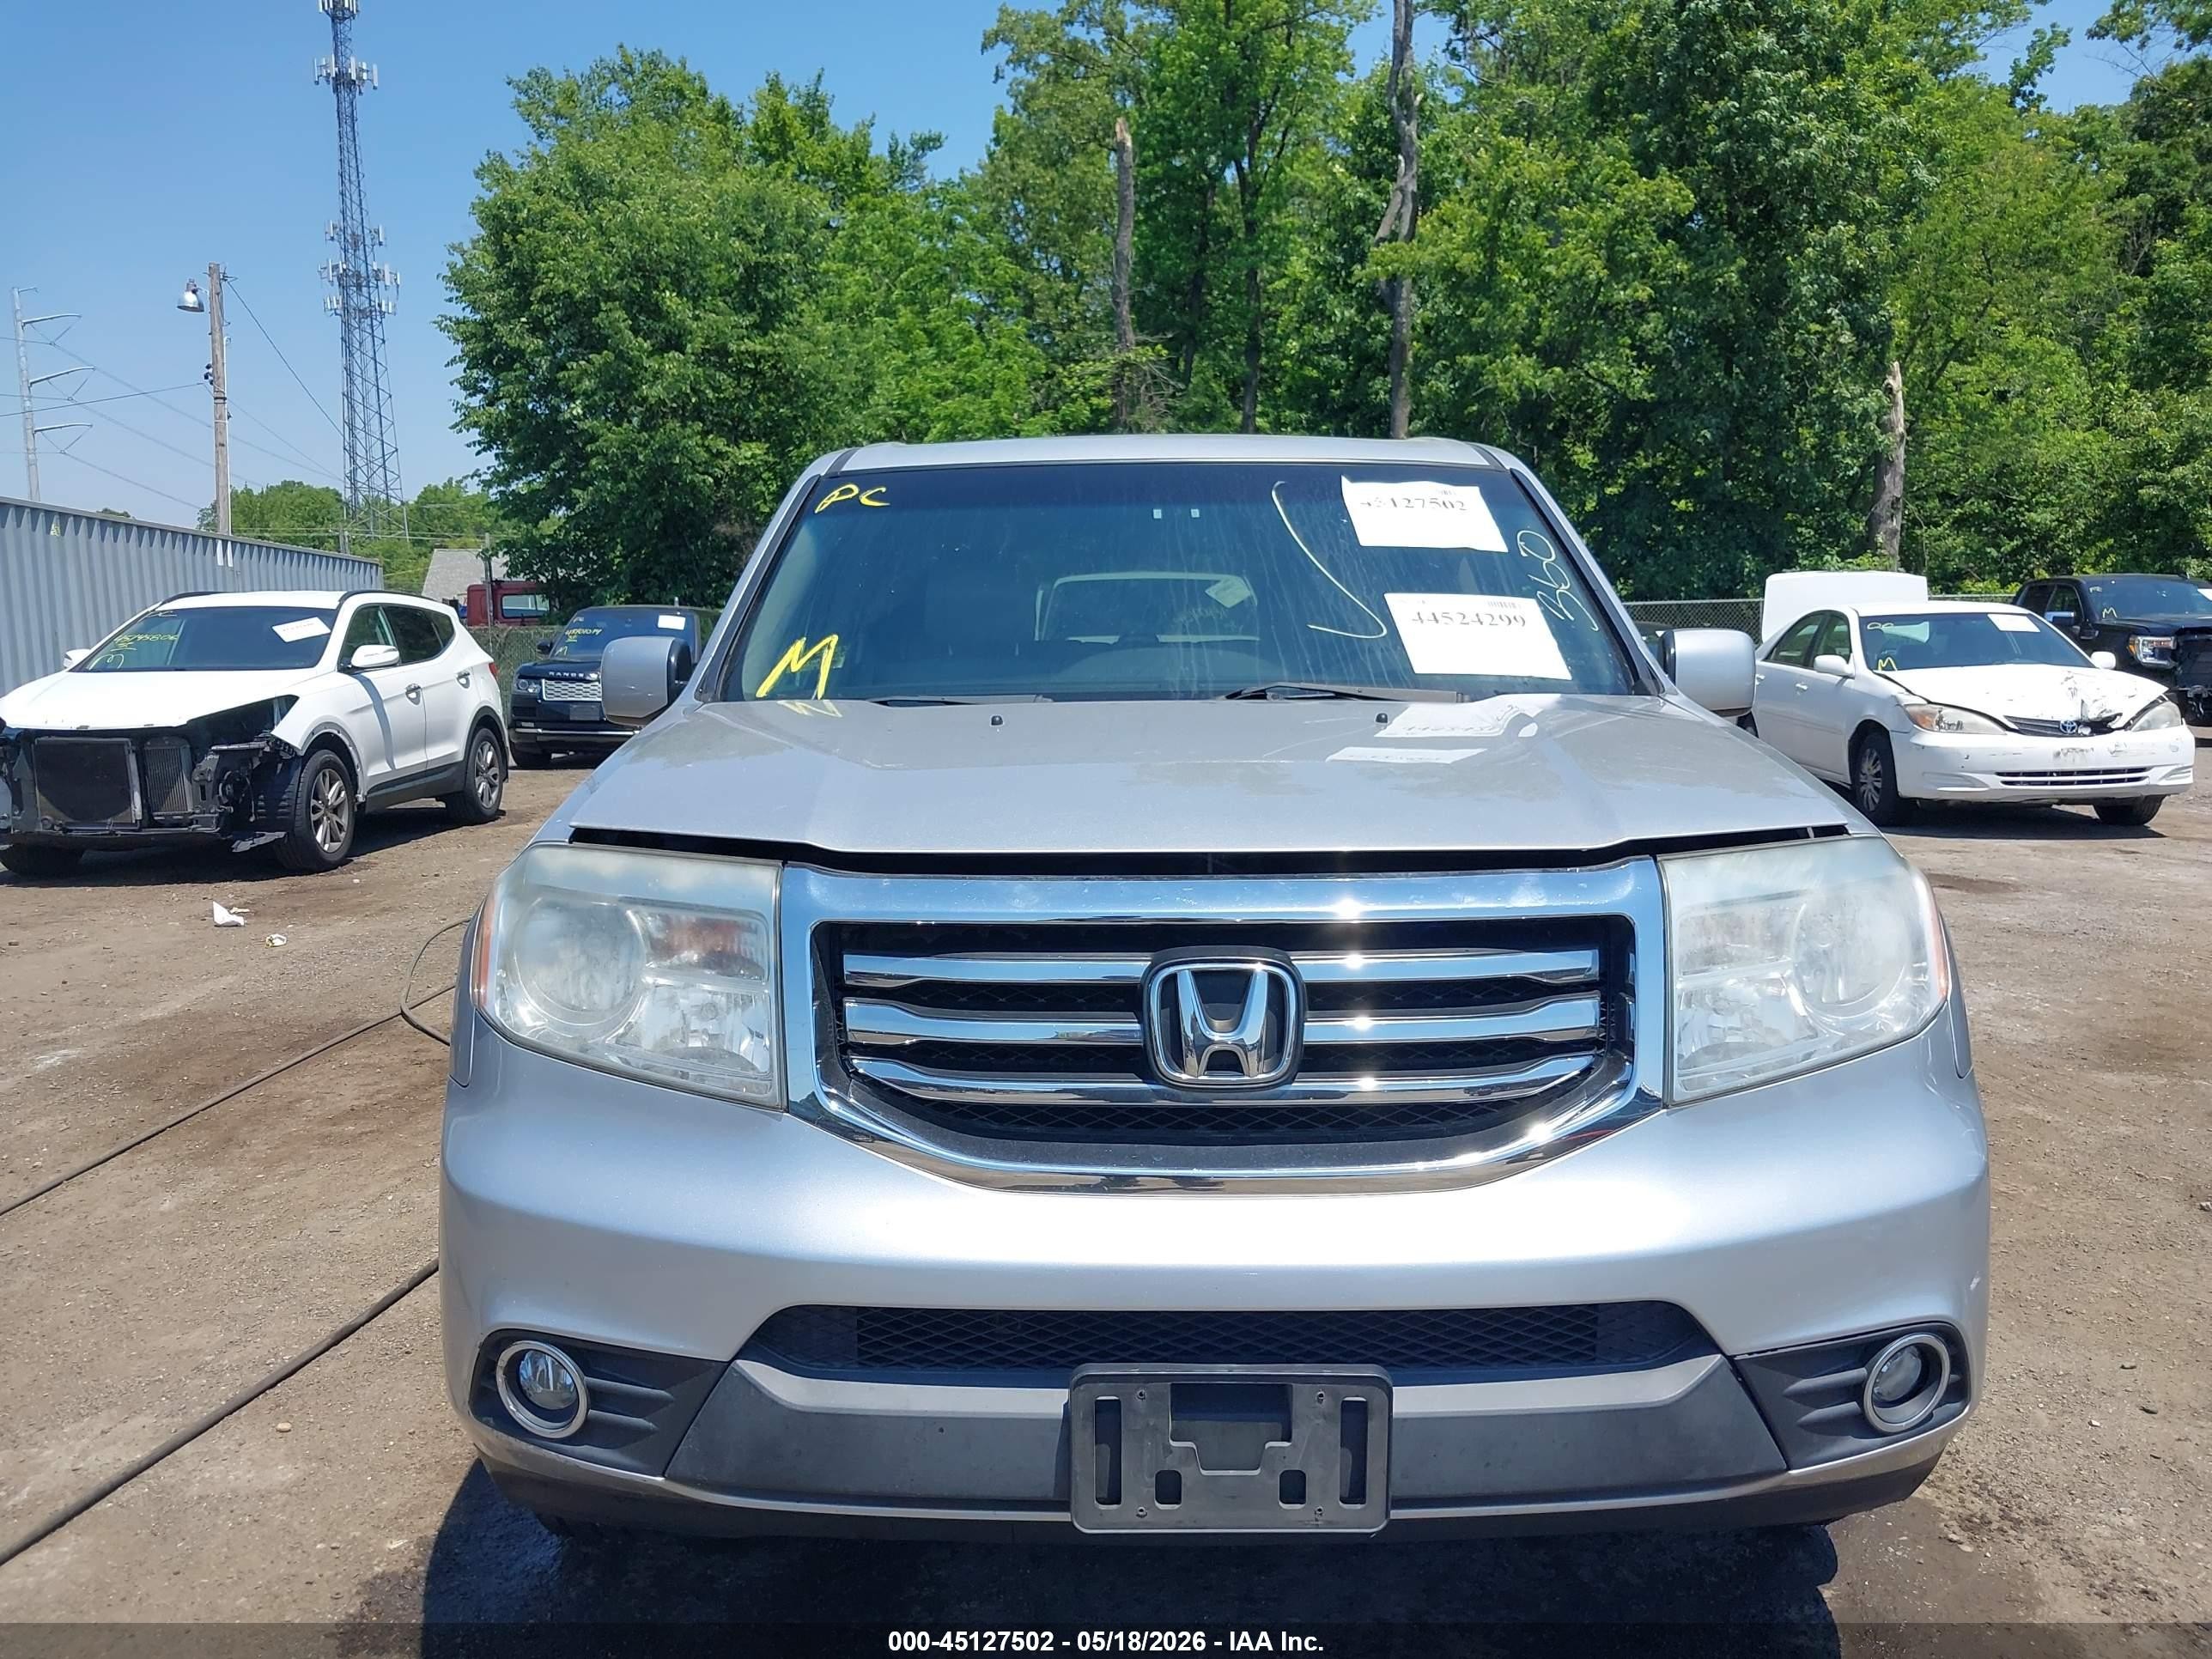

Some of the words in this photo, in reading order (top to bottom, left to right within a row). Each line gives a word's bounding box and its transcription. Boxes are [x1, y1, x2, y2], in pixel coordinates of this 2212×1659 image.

[815, 483, 890, 514] PC
[756, 633, 839, 701] M
[1877, 656, 1899, 672] M
